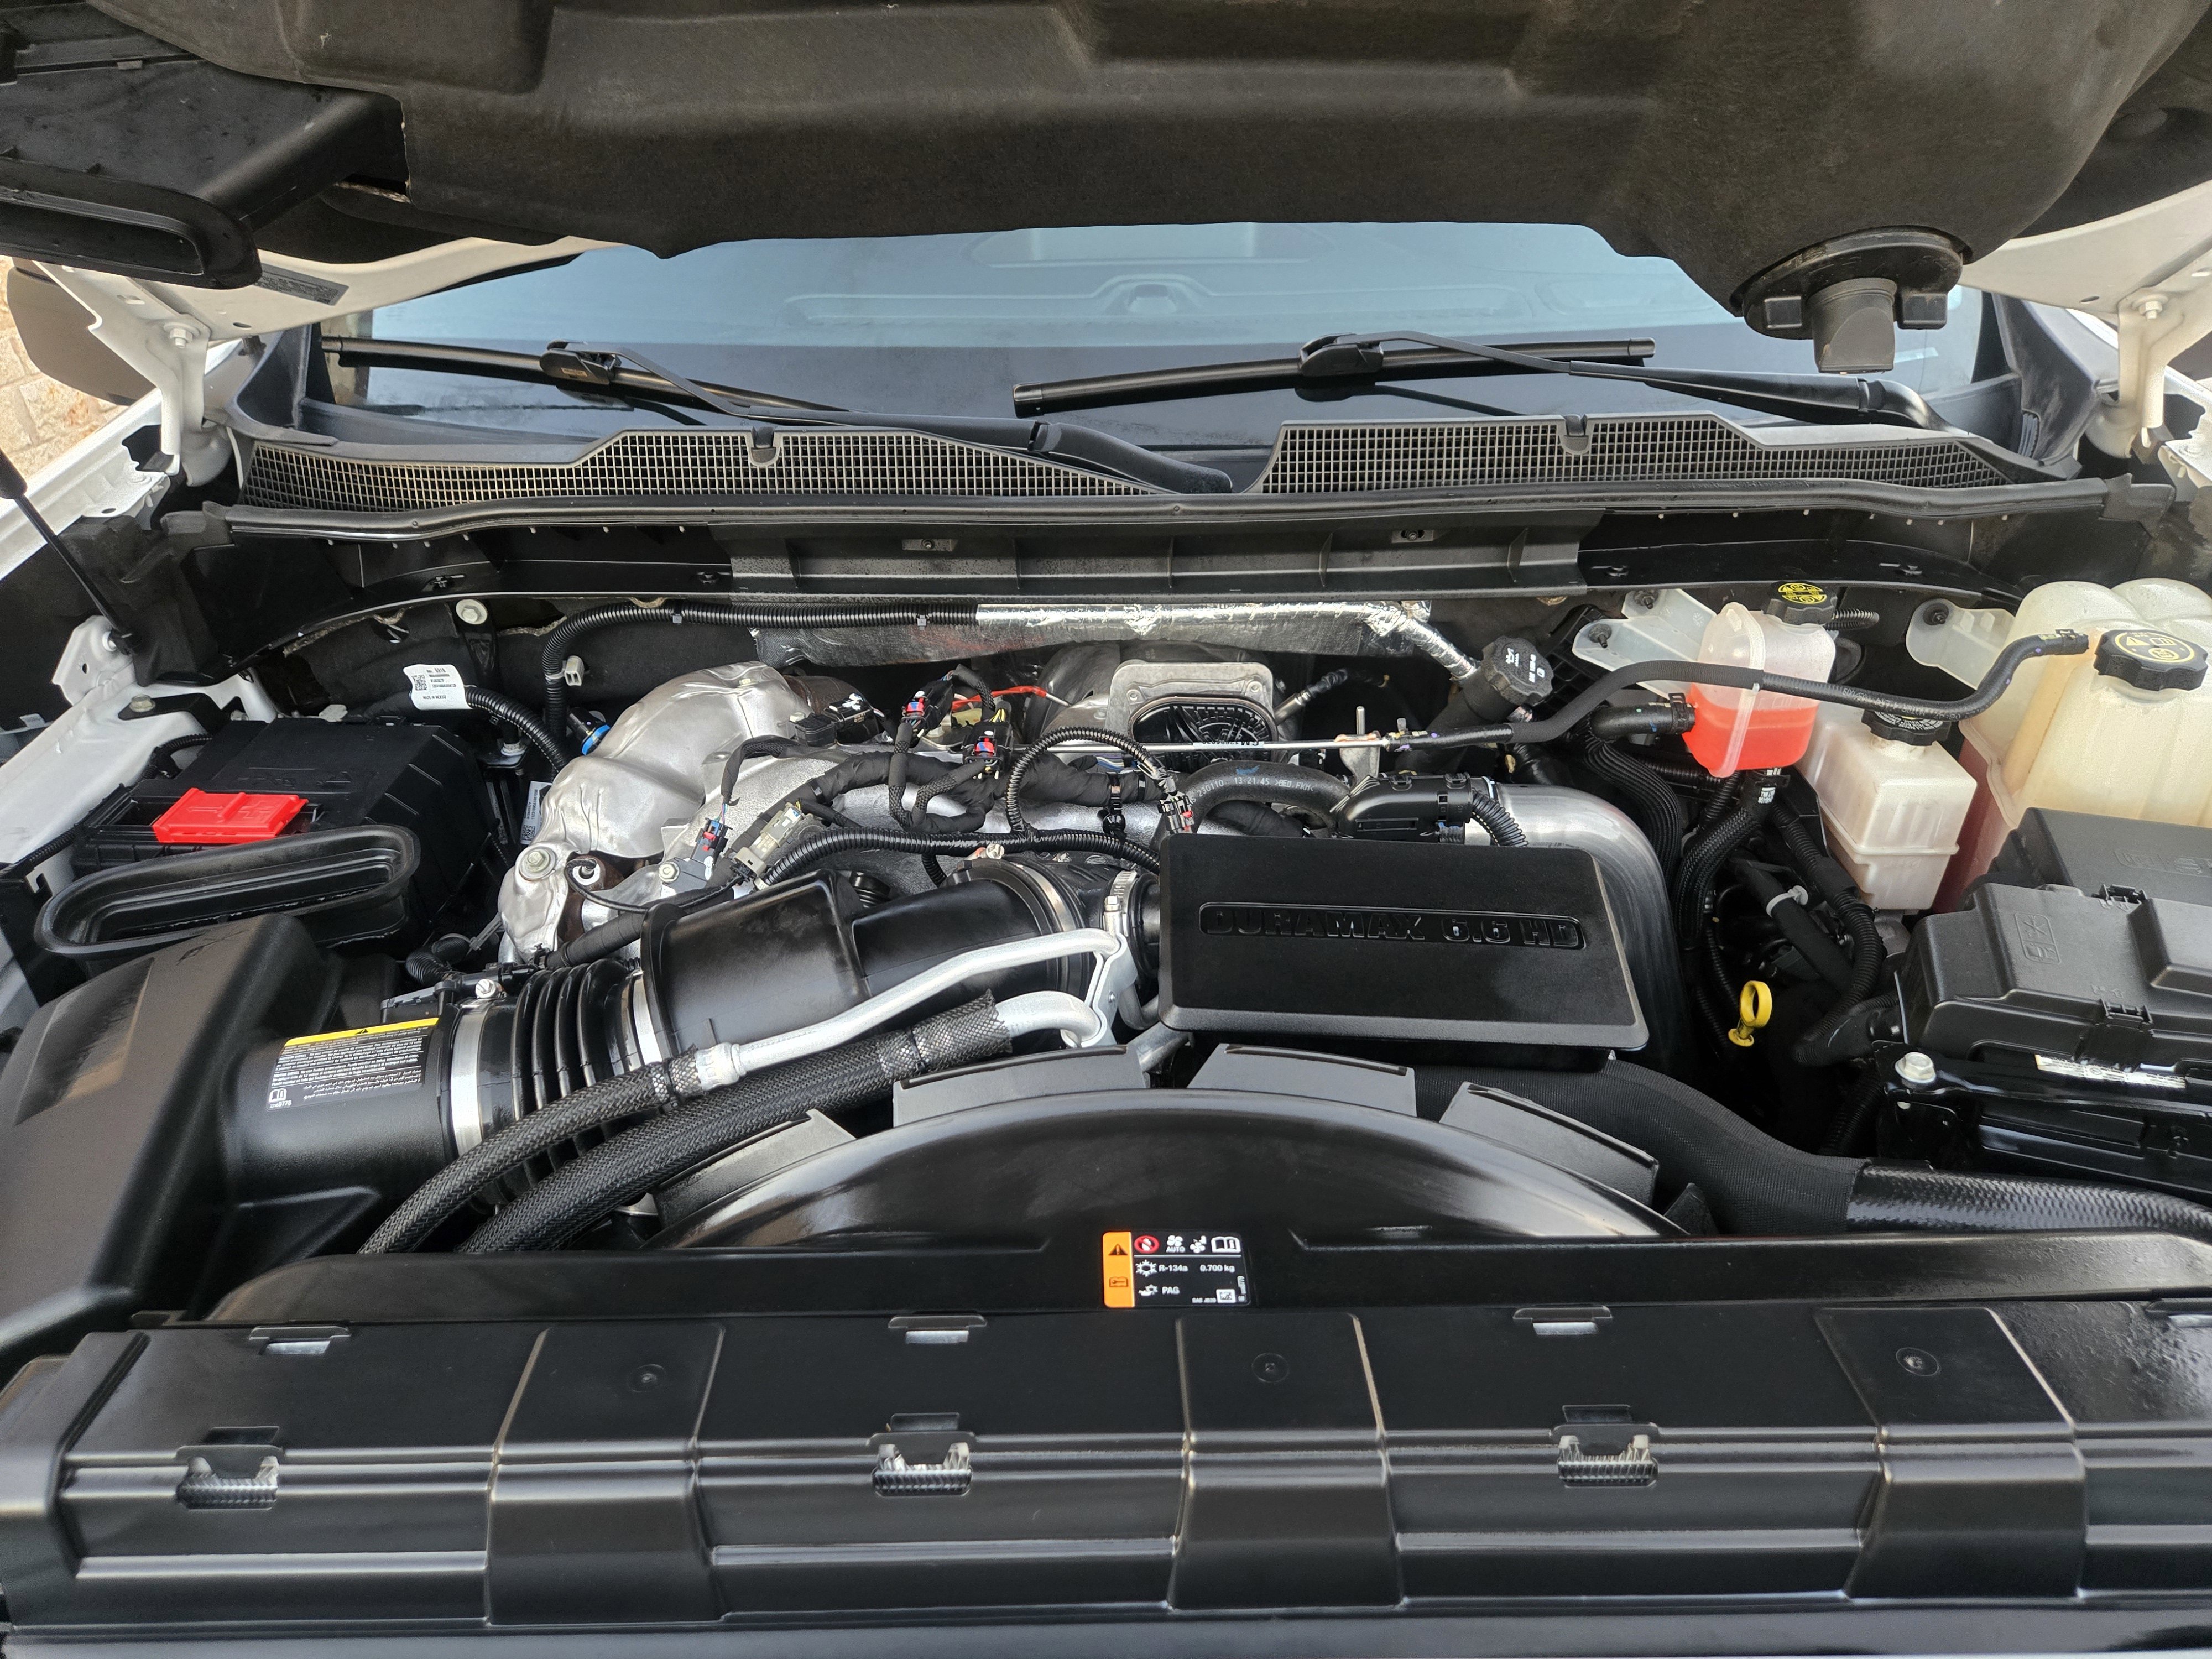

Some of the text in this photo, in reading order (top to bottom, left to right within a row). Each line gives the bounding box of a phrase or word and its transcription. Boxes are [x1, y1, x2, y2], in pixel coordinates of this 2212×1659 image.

[1197, 780, 1224, 797] 230110
[1207, 910, 1579, 947] DURAMAX 6.6 HD
[1223, 1264, 1235, 1274] kg
[1162, 1286, 1180, 1295] PAG
